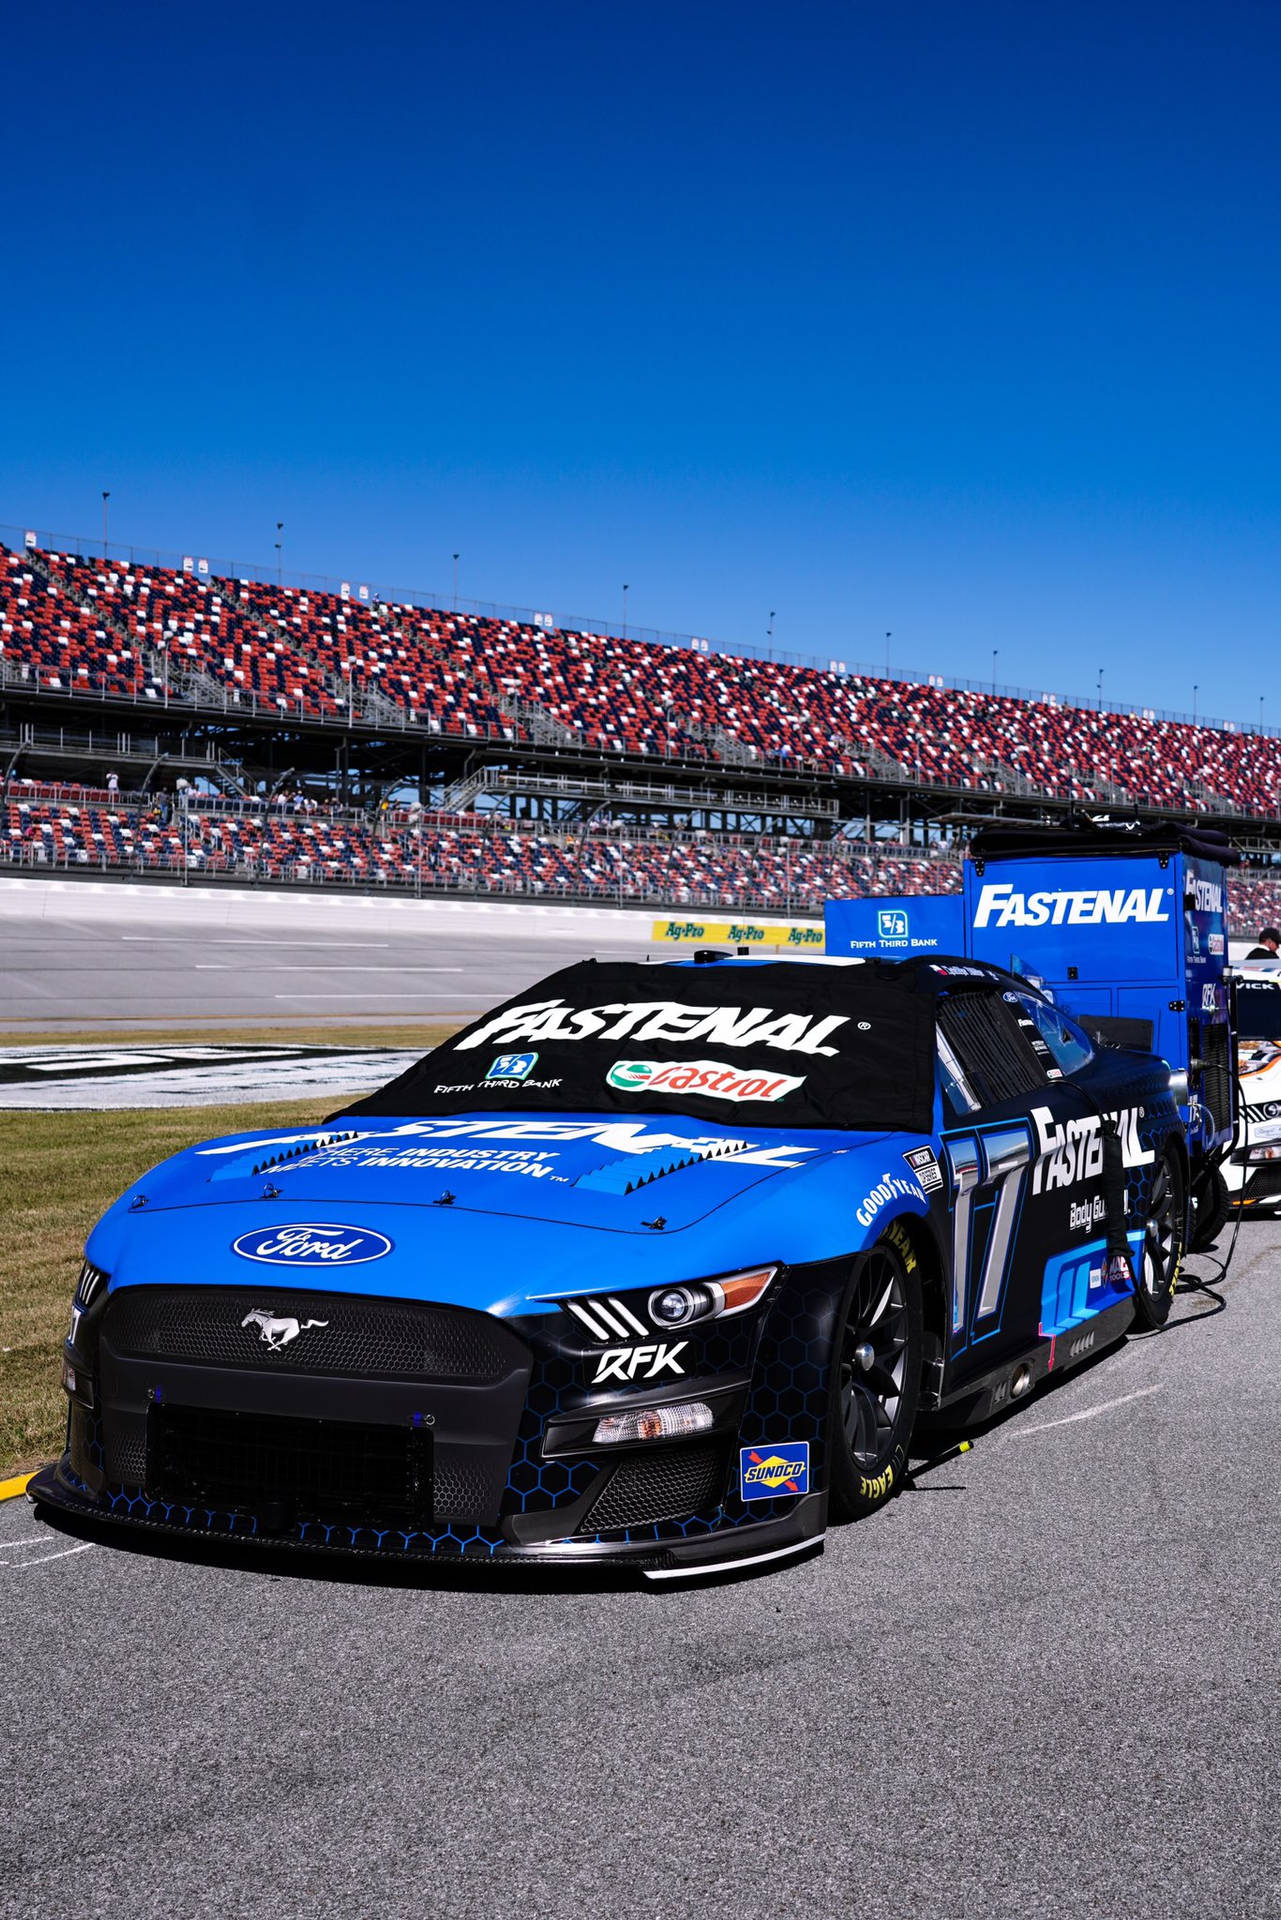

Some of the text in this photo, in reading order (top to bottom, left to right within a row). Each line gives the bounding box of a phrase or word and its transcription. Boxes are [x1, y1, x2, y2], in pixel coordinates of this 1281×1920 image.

[973, 884, 1169, 928] FASTENAL
[850, 938, 937, 949] FIFTH THIRD BANK
[453, 999, 851, 1057] FASTENAL
[433, 1078, 563, 1094] FIFTH THIRD BANK
[648, 1066, 787, 1098] Castrol
[356, 1156, 554, 1178] INNOVATION
[397, 1147, 561, 1162] INDUSTRY
[856, 1172, 927, 1227] GOODYEAR
[1070, 1199, 1093, 1233] Body
[256, 1227, 365, 1261] Ford
[591, 1341, 690, 1384] RFK
[746, 1463, 803, 1481] SUNOCO
[859, 1464, 894, 1499] EAGLE
